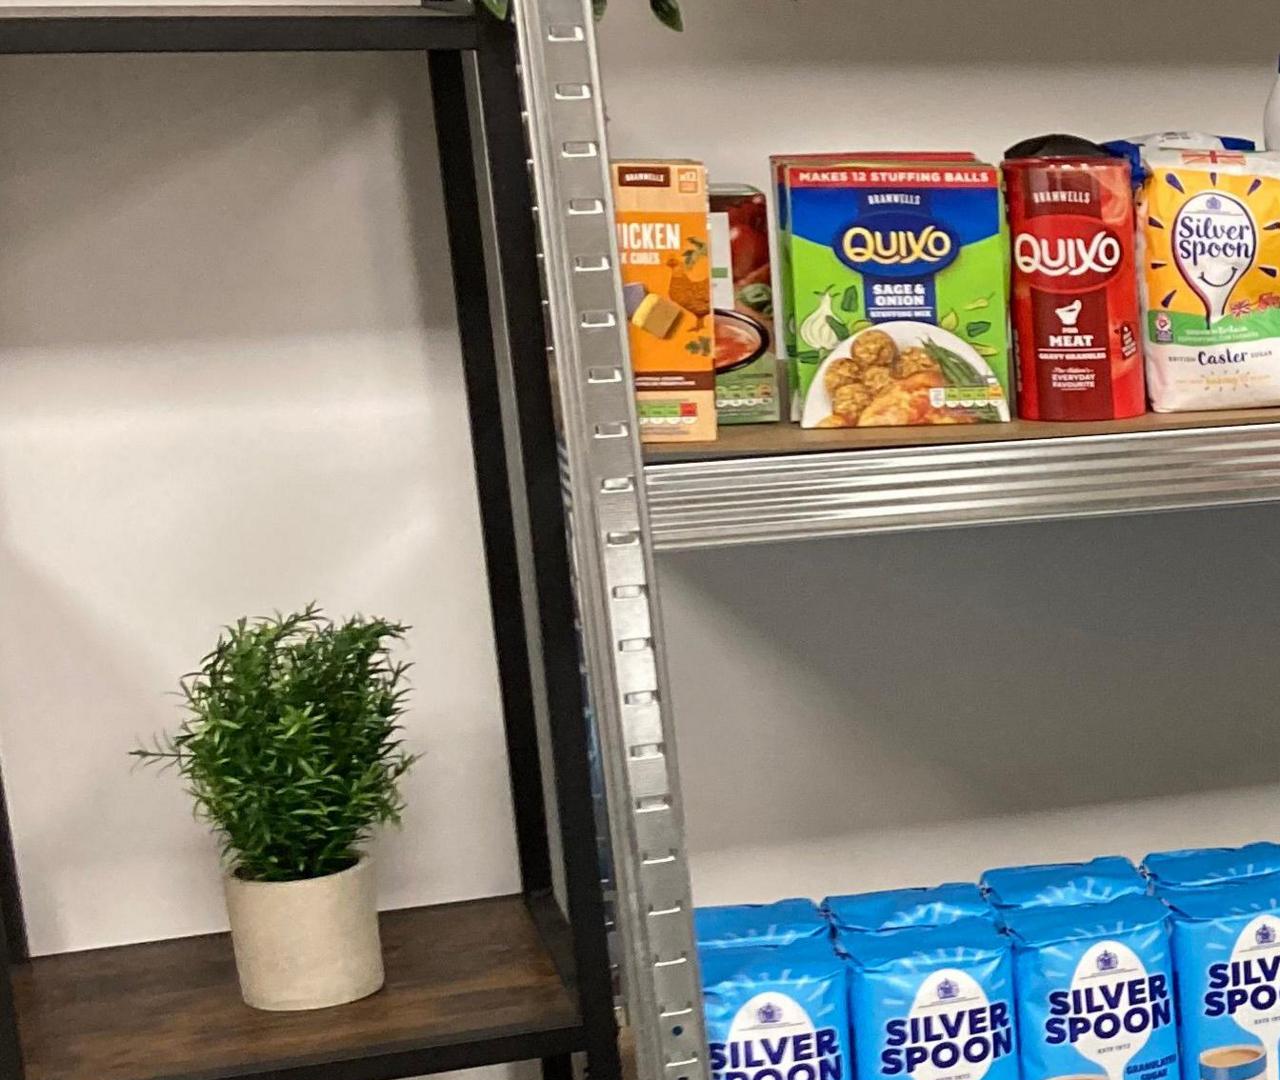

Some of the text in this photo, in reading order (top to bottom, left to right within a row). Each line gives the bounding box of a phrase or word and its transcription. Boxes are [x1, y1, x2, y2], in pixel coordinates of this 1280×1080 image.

[799, 171, 988, 182] MAKES 12 STUFFING BALLS
[842, 225, 951, 265] QUIXO
[1178, 216, 1250, 241] Silver
[1014, 231, 1120, 276] QUIXO
[873, 284, 925, 295] SAGE &
[875, 295, 925, 306] ONION
[1049, 335, 1094, 347] MEAT
[1198, 348, 1248, 365] Caster
[1049, 974, 1168, 1016] SILVER
[886, 1002, 1009, 1046] SILVER
[1045, 999, 1171, 1045] SPOON
[708, 1028, 838, 1071] SILVER
[880, 1027, 1012, 1076] SPOON
